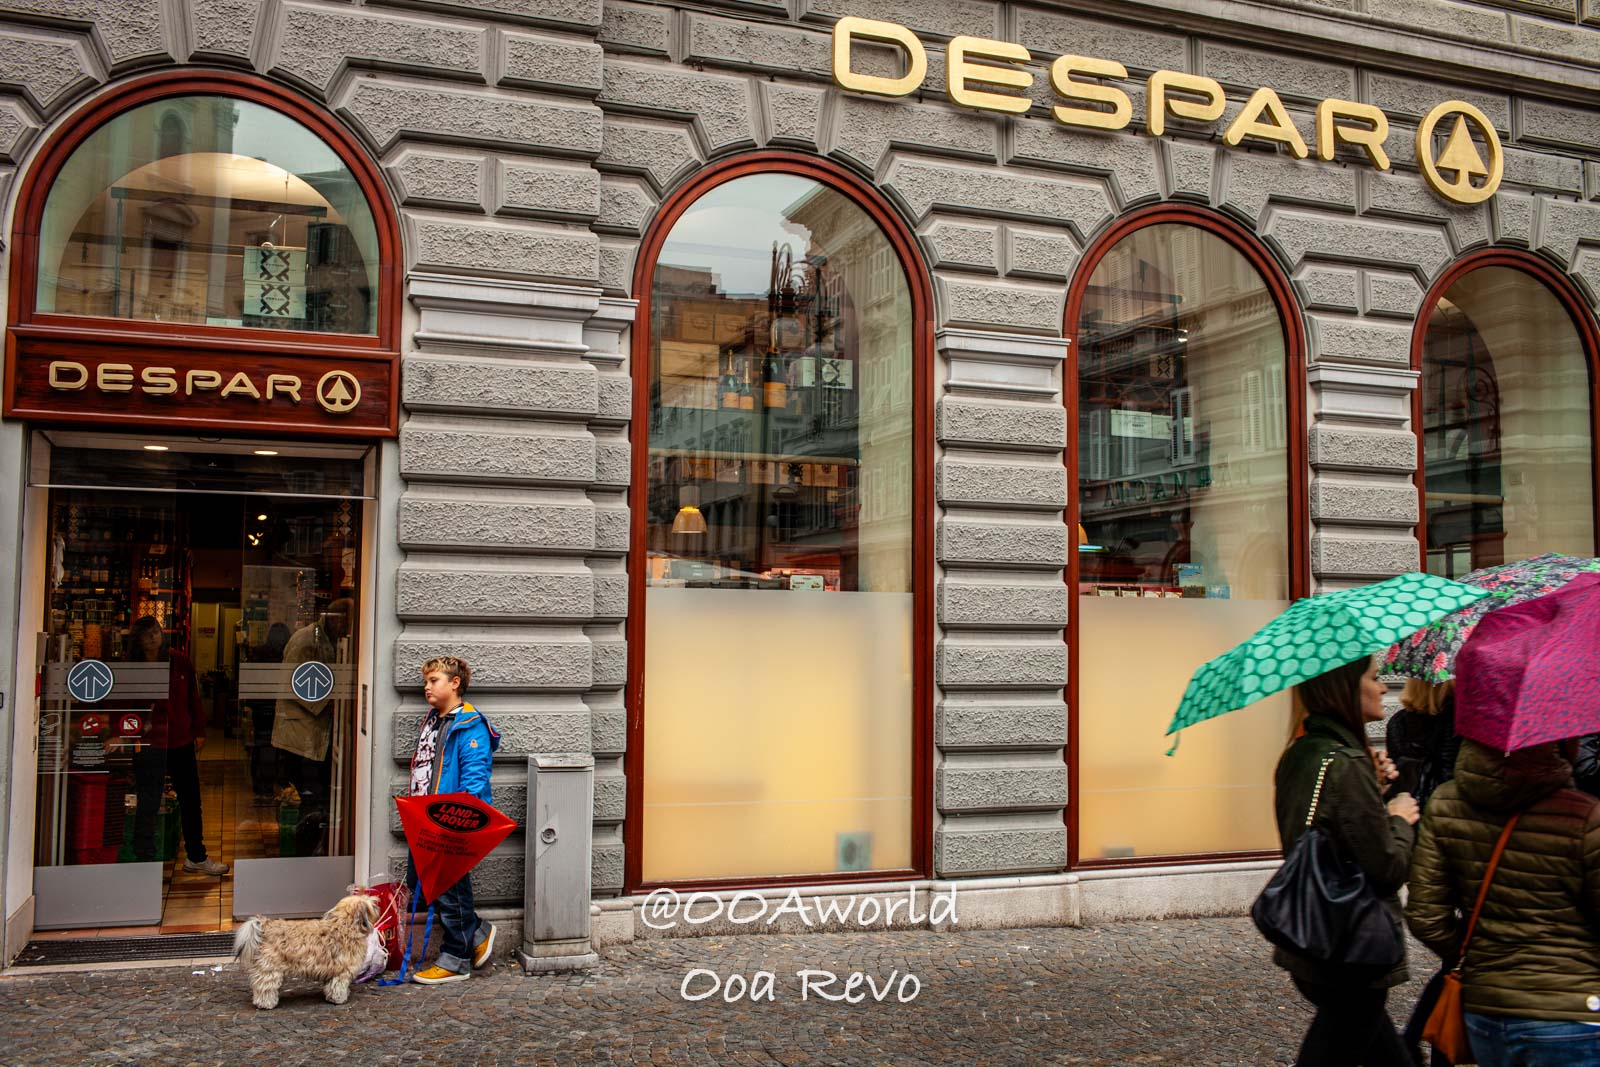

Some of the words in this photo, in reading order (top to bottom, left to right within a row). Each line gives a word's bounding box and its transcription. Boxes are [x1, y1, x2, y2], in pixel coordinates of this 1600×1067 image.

[832, 16, 1391, 171] DESPAR
[48, 360, 303, 403] DESPAR
[439, 804, 474, 819] LAND
[440, 814, 480, 828] ROVER
